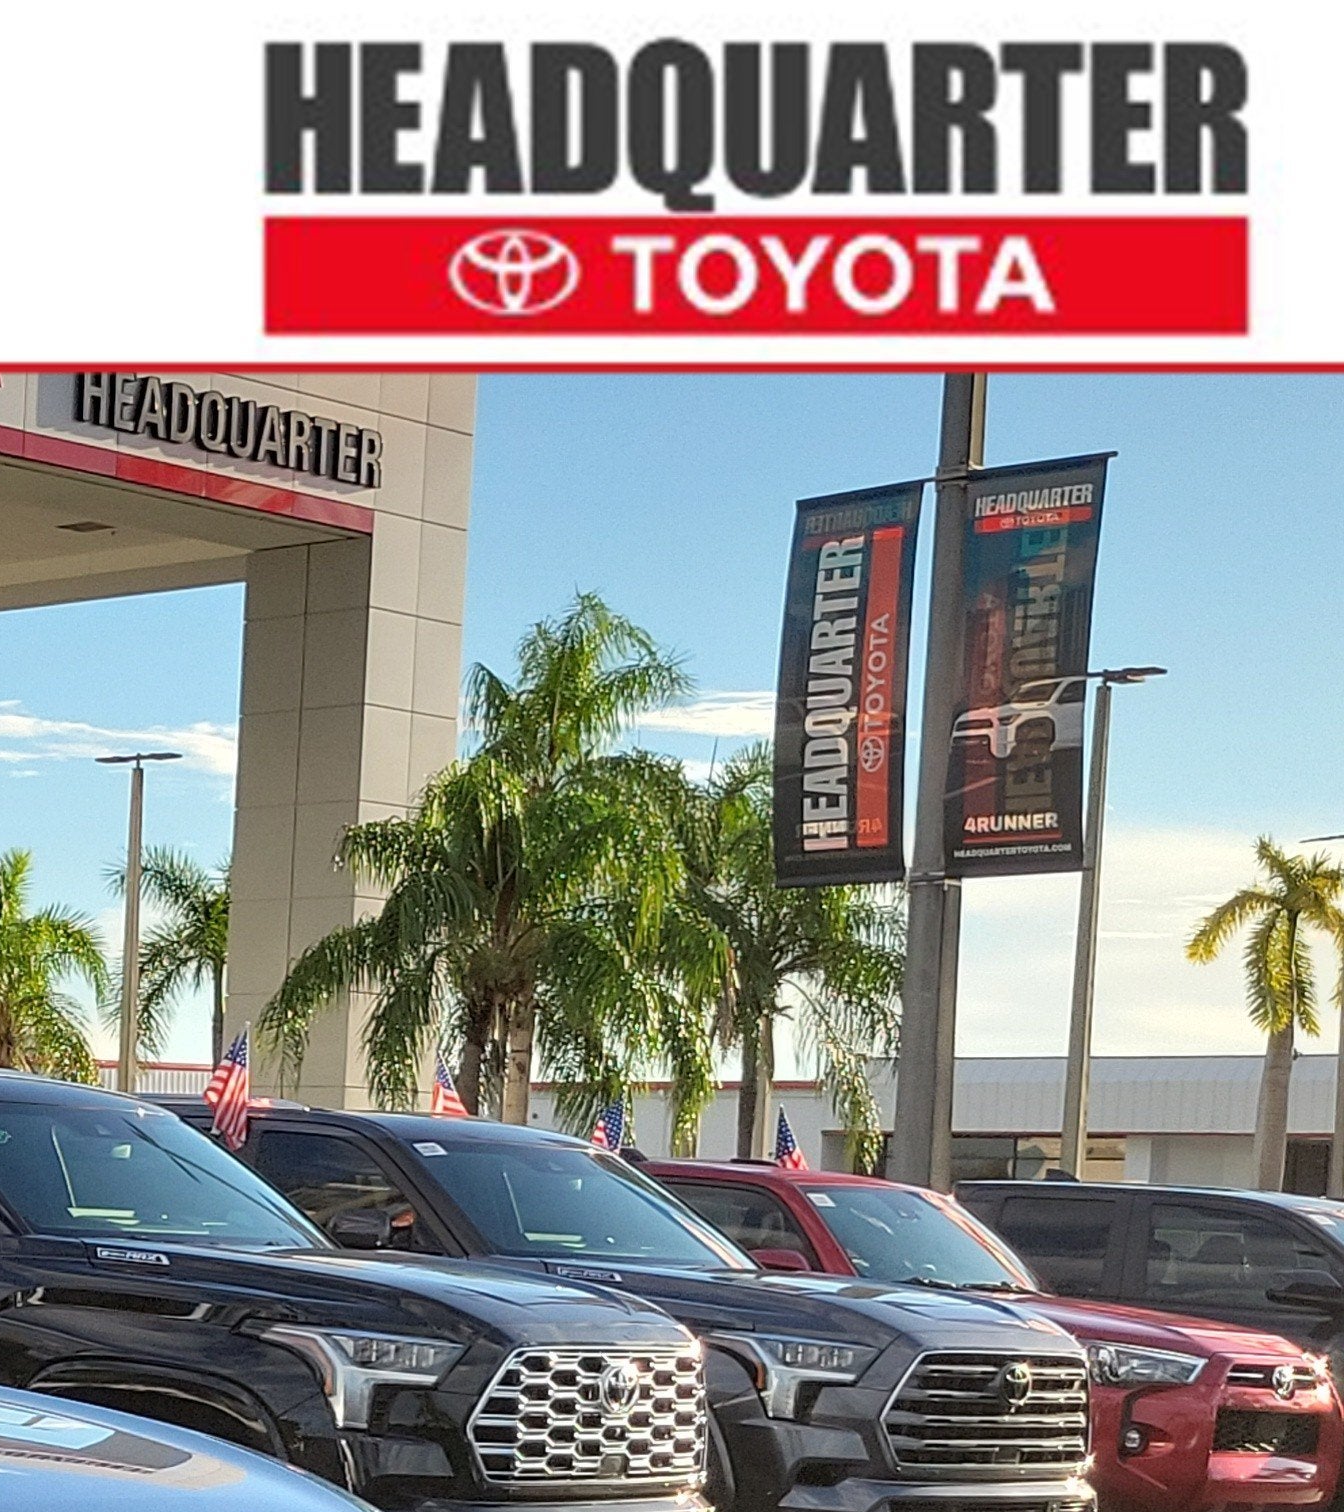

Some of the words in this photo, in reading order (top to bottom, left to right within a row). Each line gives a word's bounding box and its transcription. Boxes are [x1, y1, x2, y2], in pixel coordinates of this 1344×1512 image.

[76, 373, 383, 489] HEADQUARTER
[974, 483, 1094, 517] HEADQUARTER
[1013, 512, 1060, 527] TOYOTA
[801, 534, 866, 852] HEADQUARTER
[861, 613, 890, 734] TOYOTA
[964, 812, 1059, 834] 4RUNNER
